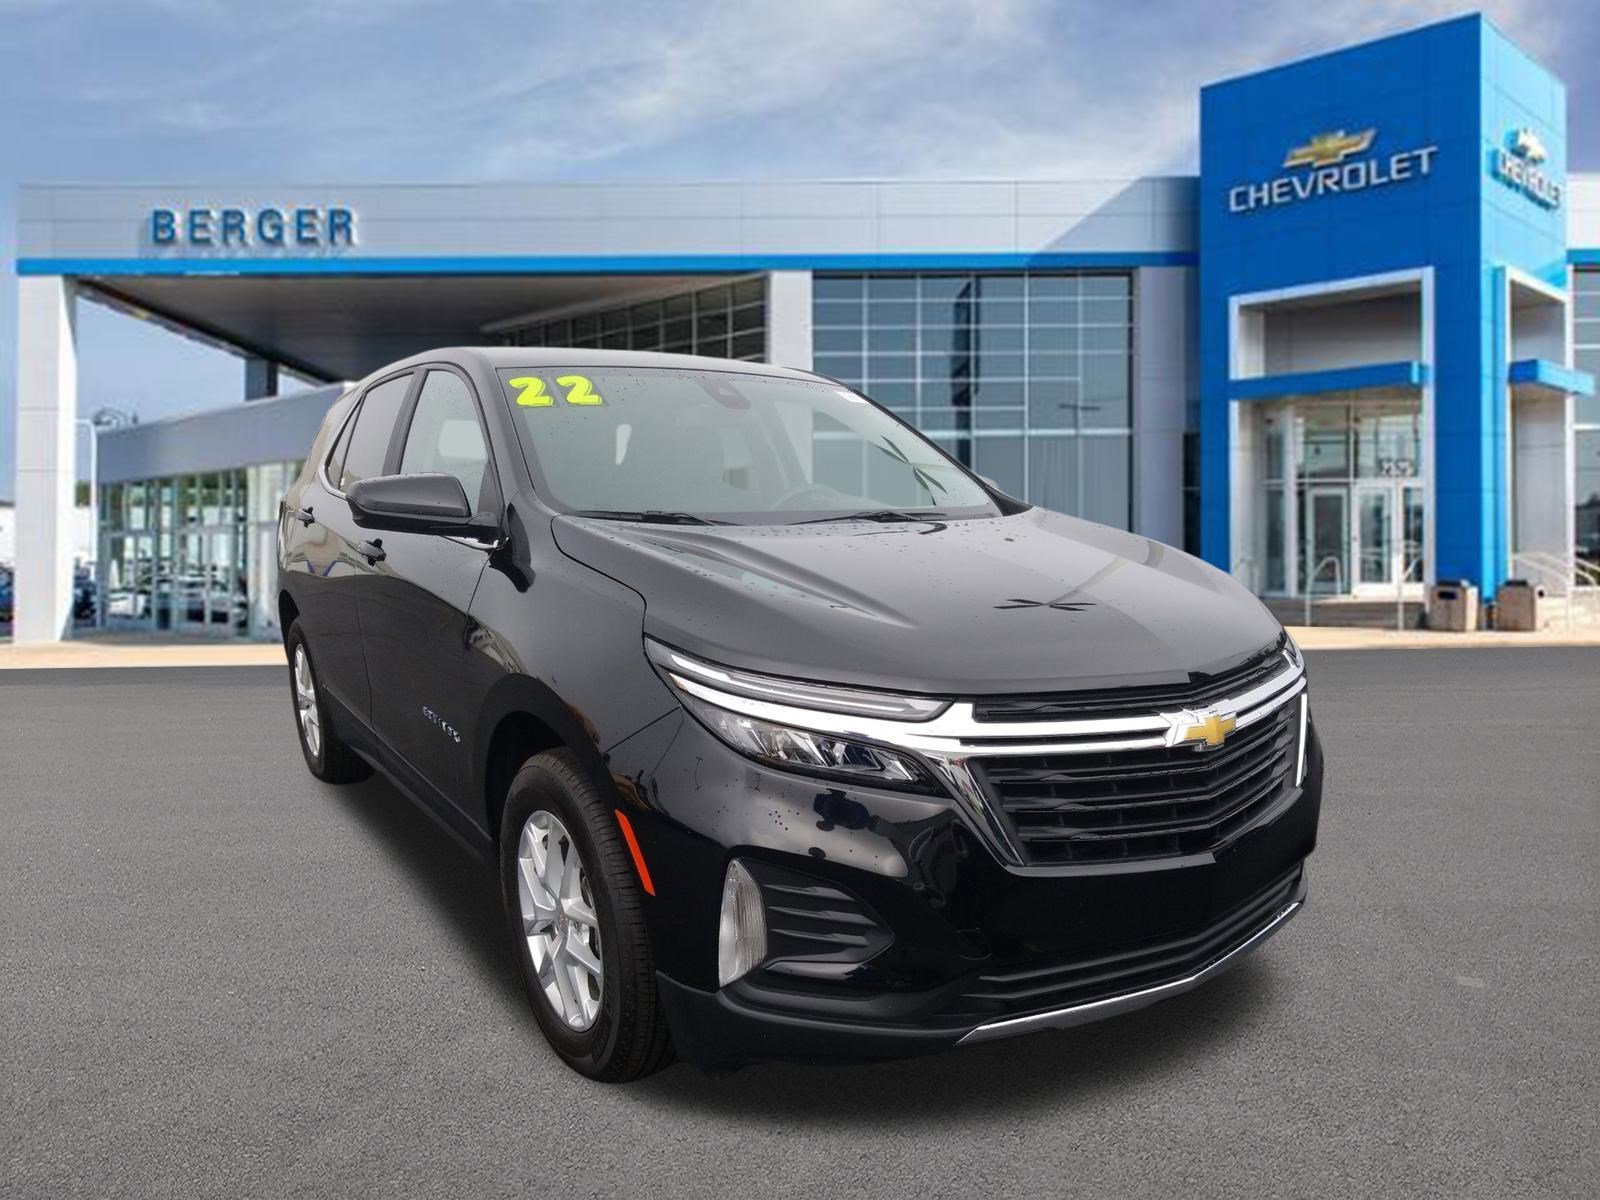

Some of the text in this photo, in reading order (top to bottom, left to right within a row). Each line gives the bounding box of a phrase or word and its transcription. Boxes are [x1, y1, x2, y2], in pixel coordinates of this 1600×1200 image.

[1229, 145, 1439, 213] CHEVROLET
[152, 208, 357, 245] BERGER
[508, 375, 603, 407] 22
